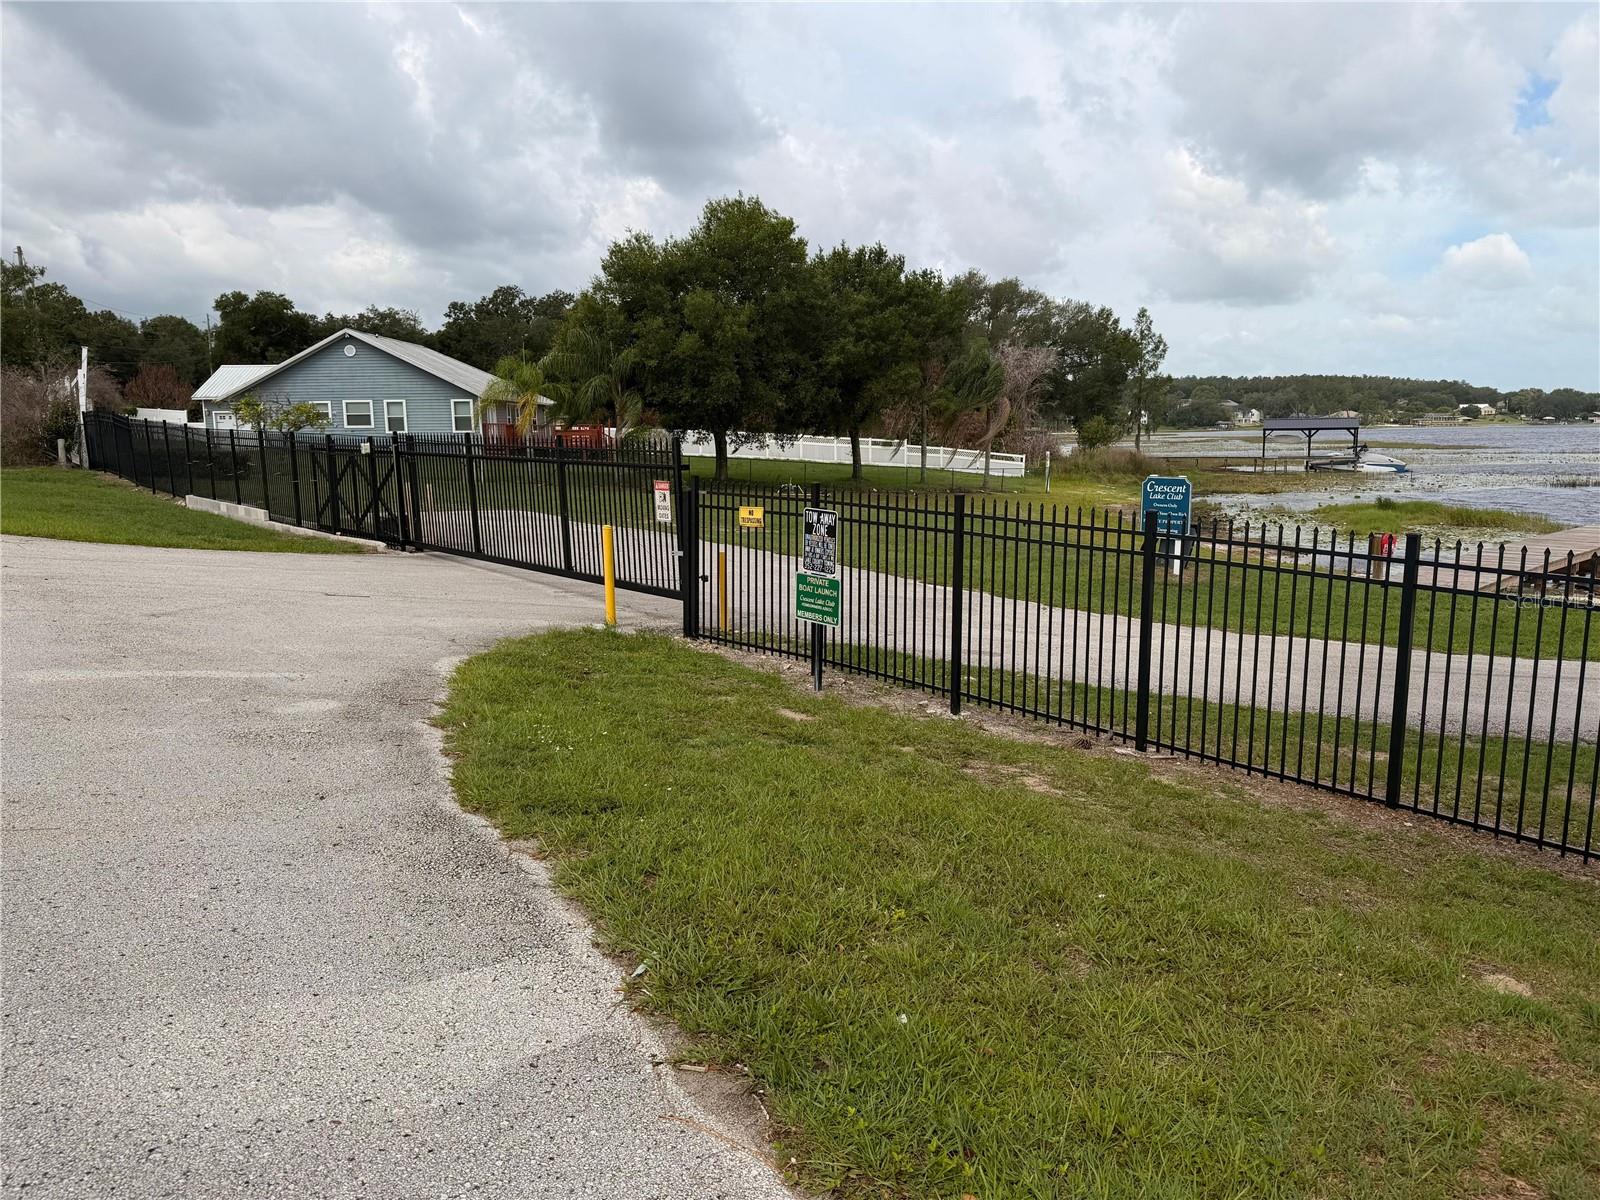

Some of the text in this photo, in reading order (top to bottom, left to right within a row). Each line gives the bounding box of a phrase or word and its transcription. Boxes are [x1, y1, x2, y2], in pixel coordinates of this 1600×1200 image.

[1147, 481, 1187, 493] Crescent
[1166, 492, 1184, 500] Club
[805, 511, 836, 526] TOW AWAY
[812, 524, 828, 537] ZONE
[807, 576, 829, 587] PRIVATE
[799, 584, 837, 597] BOAT LAUNCH
[797, 610, 837, 624] MEMBERS ONLY
